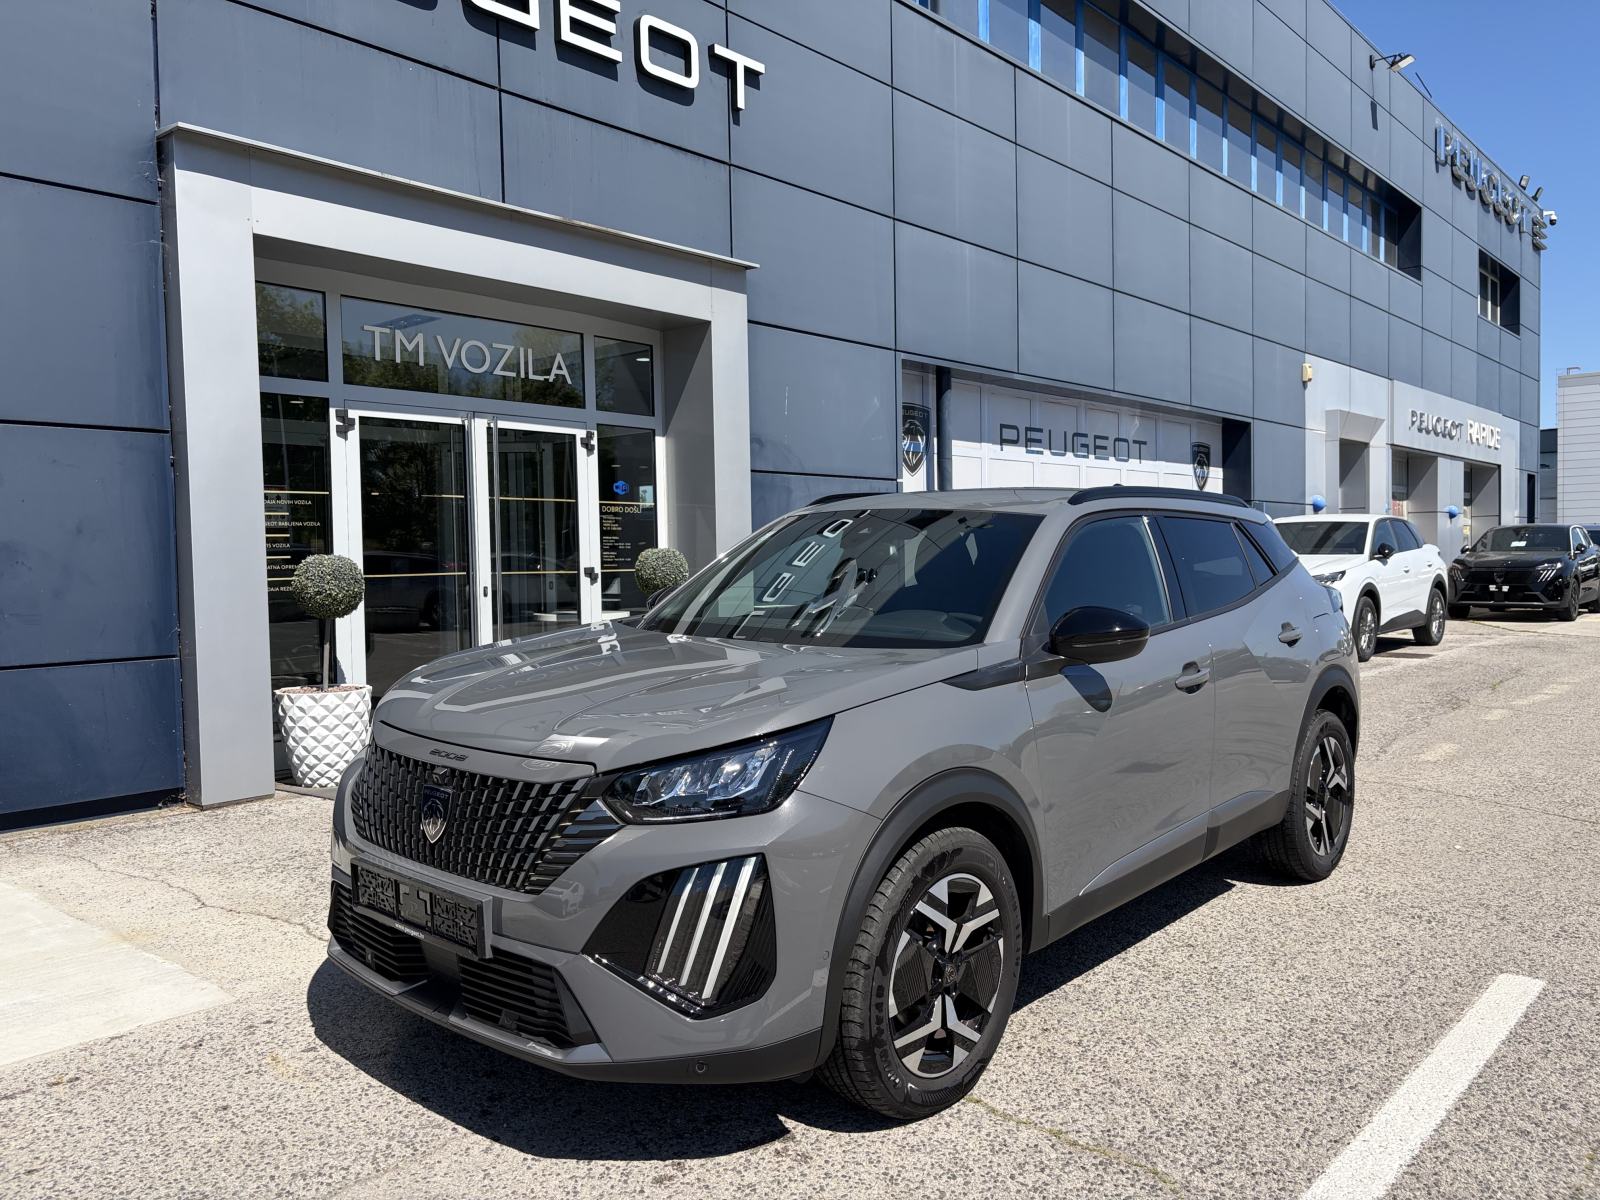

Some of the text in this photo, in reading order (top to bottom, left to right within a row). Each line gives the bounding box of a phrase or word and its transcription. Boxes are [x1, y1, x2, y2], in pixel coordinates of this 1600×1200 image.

[363, 324, 572, 385] TM VOZILA
[999, 423, 1148, 464] PEUGEOT
[1409, 409, 1501, 449] PEUGEOT RAPIDE
[601, 505, 624, 513] DOBRO
[429, 748, 469, 761] 2008
